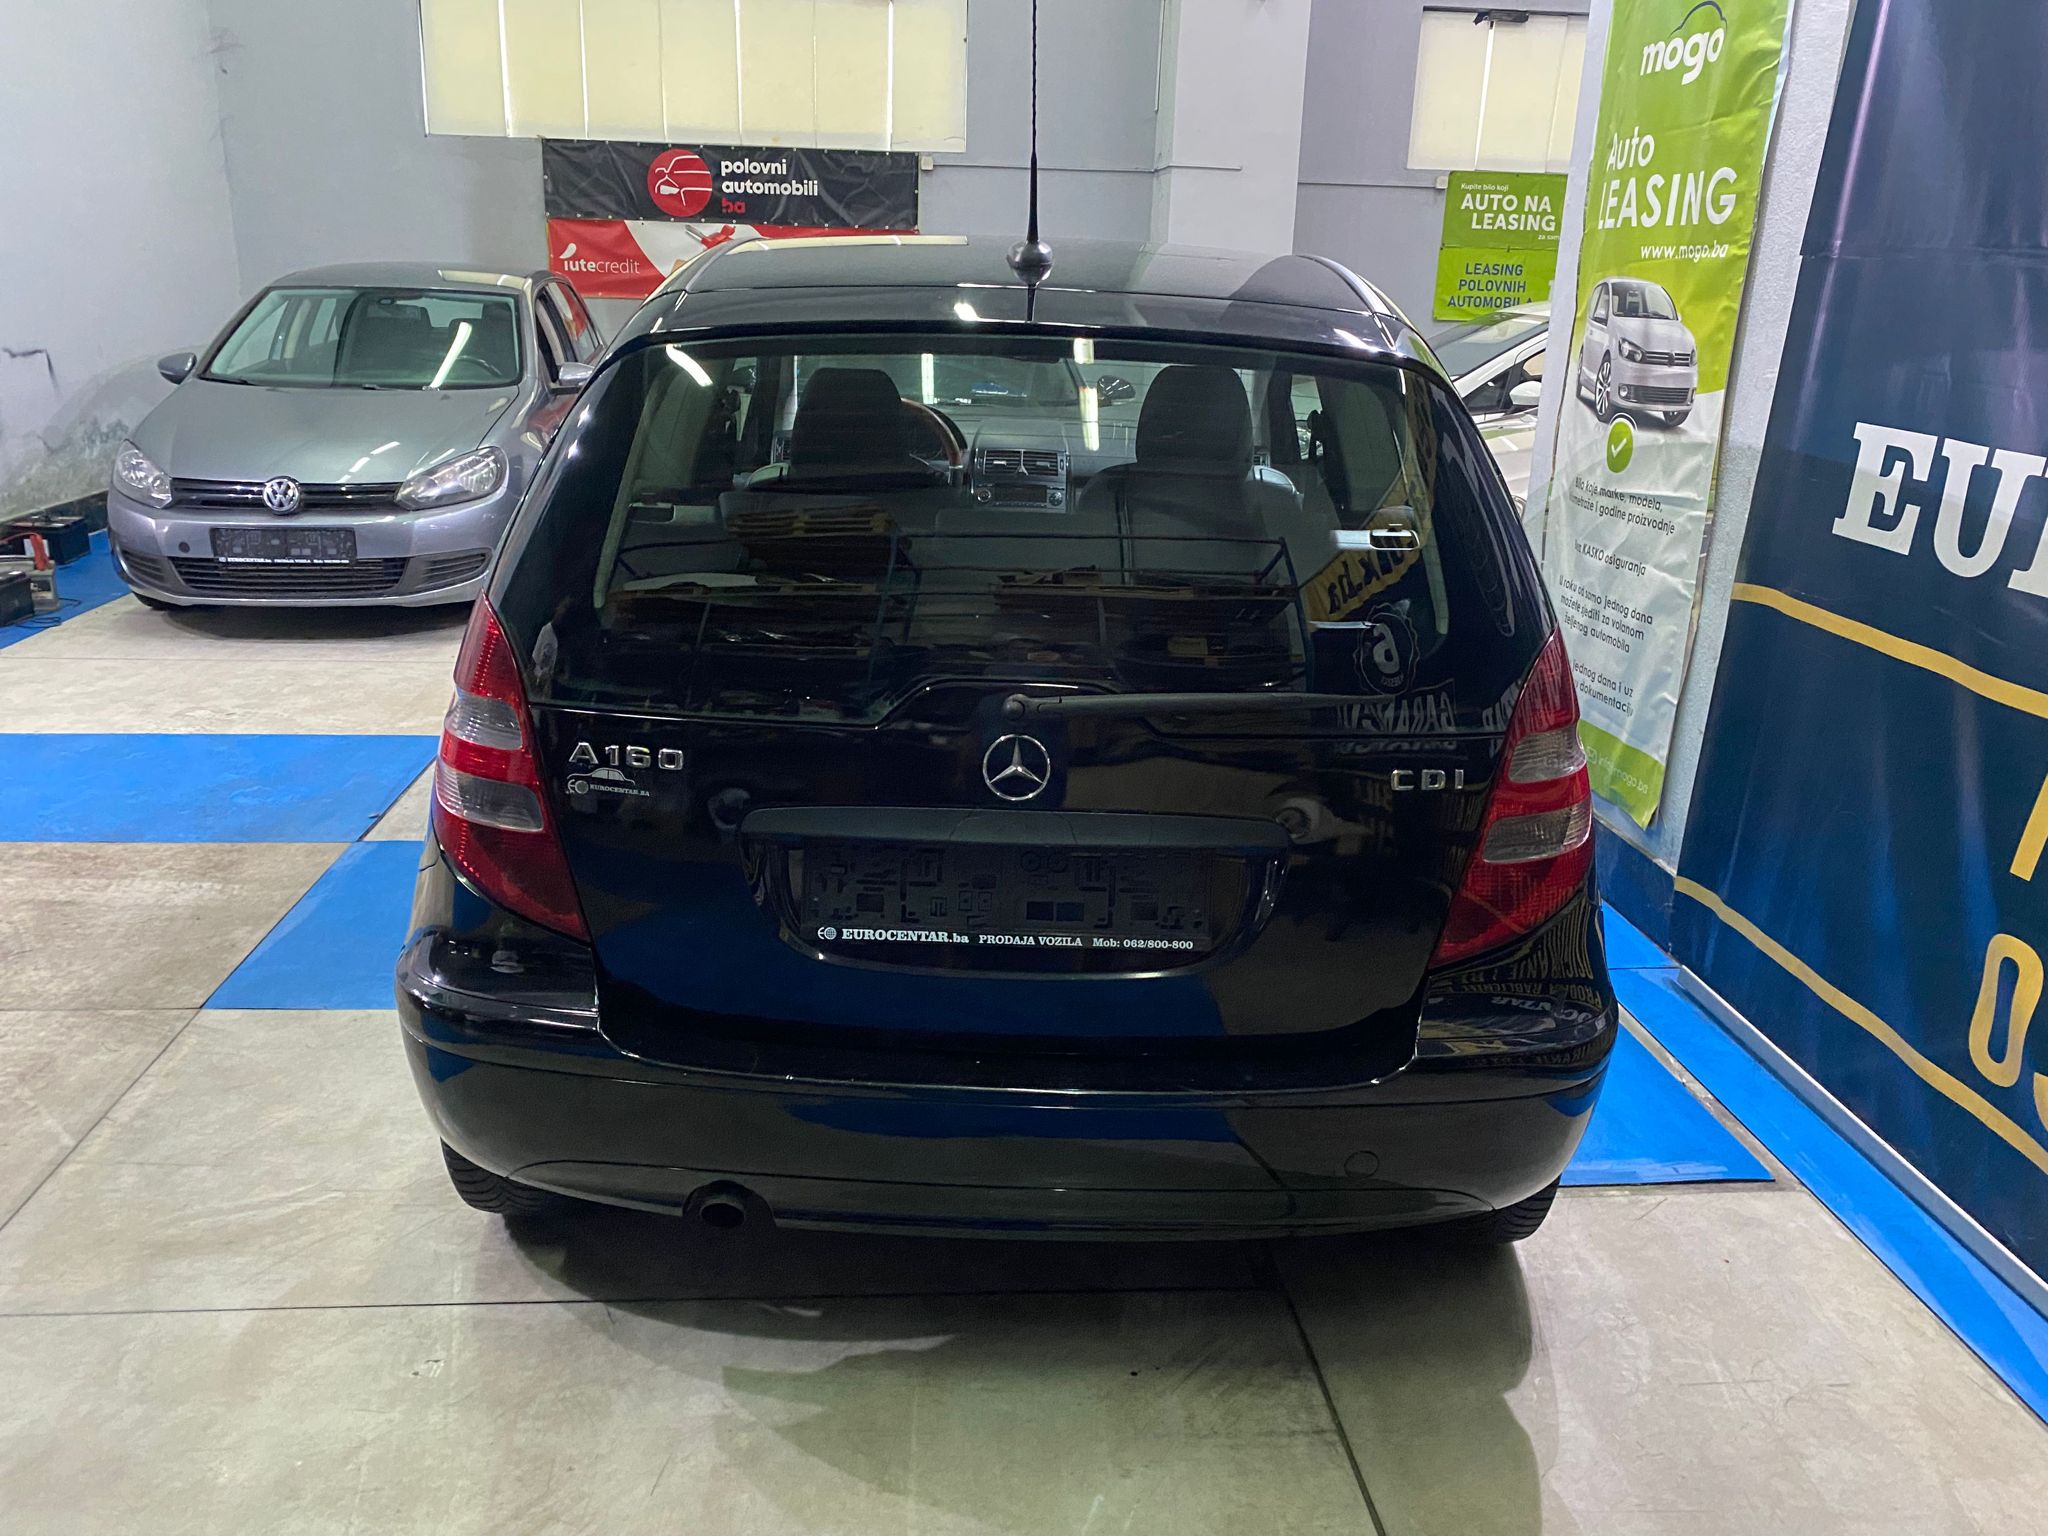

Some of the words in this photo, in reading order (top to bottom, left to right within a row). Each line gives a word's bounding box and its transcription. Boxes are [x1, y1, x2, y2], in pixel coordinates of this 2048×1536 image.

[1640, 28, 1725, 85] mogo
[1607, 127, 1655, 171] Auto
[721, 158, 787, 177] polovni
[722, 179, 818, 197] automobili
[1461, 183, 1482, 192] Kupite
[1497, 184, 1509, 193] koji
[1598, 167, 1738, 230] LEASING
[1460, 193, 1518, 211] AUTO
[1524, 195, 1551, 212] NA
[1472, 213, 1556, 231] LEASING
[1641, 240, 1729, 262] www.mogo.ba
[564, 256, 640, 274] iutecredit
[1465, 263, 1524, 276] LEASING
[1458, 279, 1526, 293] POLOVNIH
[1586, 481, 1598, 497] koje
[1599, 487, 1627, 503] marke,
[1629, 495, 1663, 512] modela,
[1599, 504, 1626, 520] godine
[1627, 513, 1675, 535] proizvodnje
[1582, 543, 1604, 561] KASKO
[1605, 554, 1646, 576] osiguranja
[1564, 579, 1577, 592] roku
[1585, 590, 1602, 604] samo
[1603, 595, 1629, 618] jednog
[1631, 608, 1653, 625] dana
[1561, 595, 1580, 612] možete
[1601, 614, 1610, 625] za
[1612, 619, 1644, 640] volanom
[1590, 628, 1630, 653] automobila
[1597, 673, 1616, 691] dana
[1624, 686, 1634, 697] uz
[1391, 769, 1464, 791] CDI
[842, 928, 970, 943] EUROCENTAR.ba
[979, 934, 1035, 945] PRODAJA
[1038, 936, 1083, 947] VOZILA
[1093, 938, 1120, 948] Mob:
